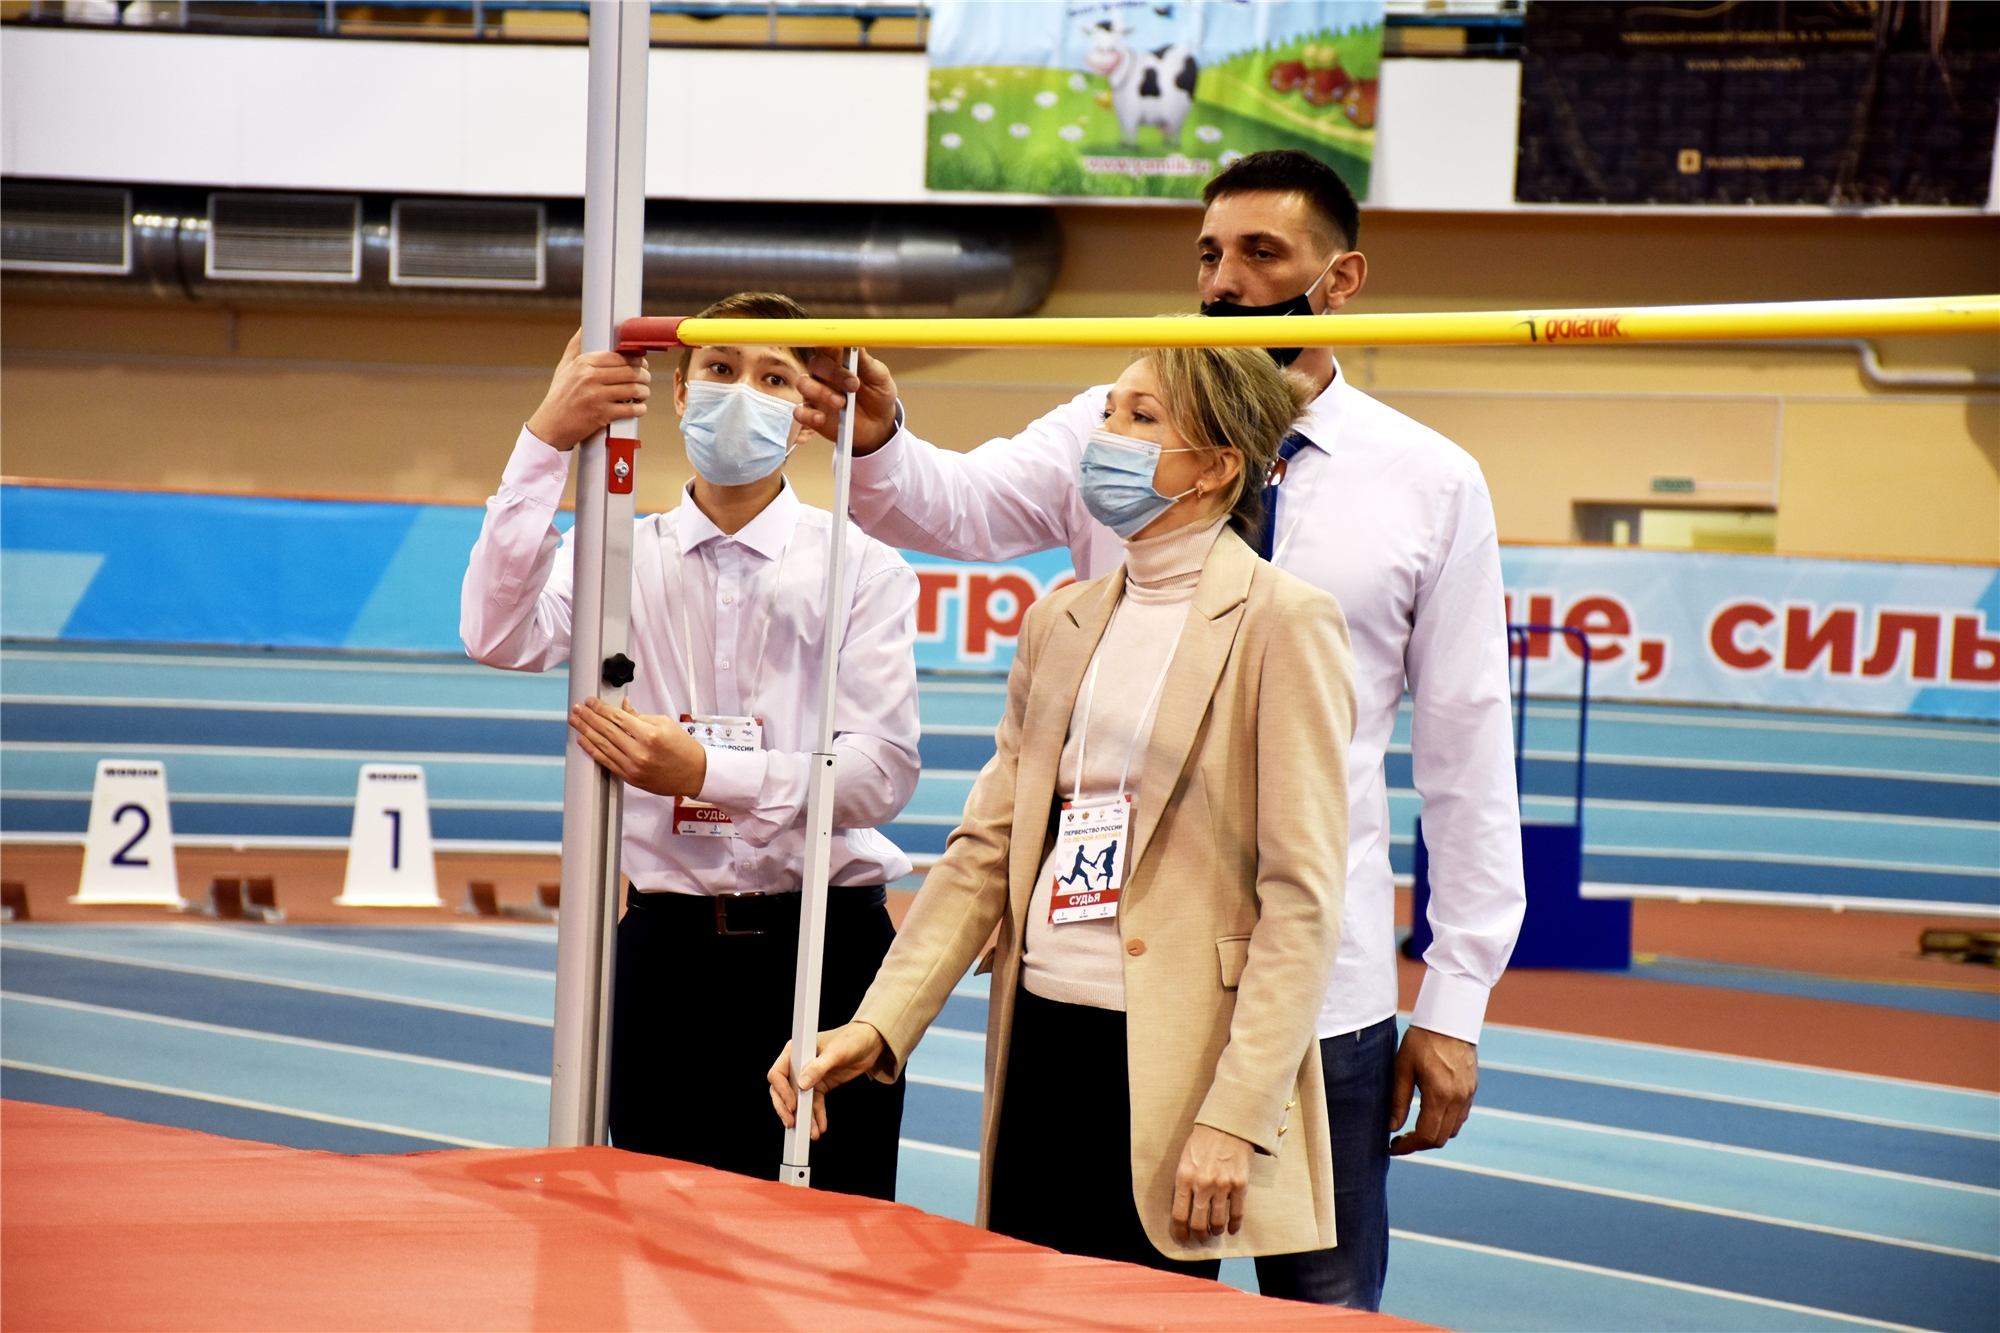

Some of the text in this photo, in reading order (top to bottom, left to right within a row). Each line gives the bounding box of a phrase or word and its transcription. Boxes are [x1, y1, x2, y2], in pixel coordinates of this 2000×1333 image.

[917, 574, 1076, 654] тр
[110, 803, 151, 866] 2
[382, 809, 401, 869] 1
[1064, 824, 1123, 837] ПЕРВЕНСТВО РОССИИ
[1069, 892, 1101, 906] СУДЬЯ
